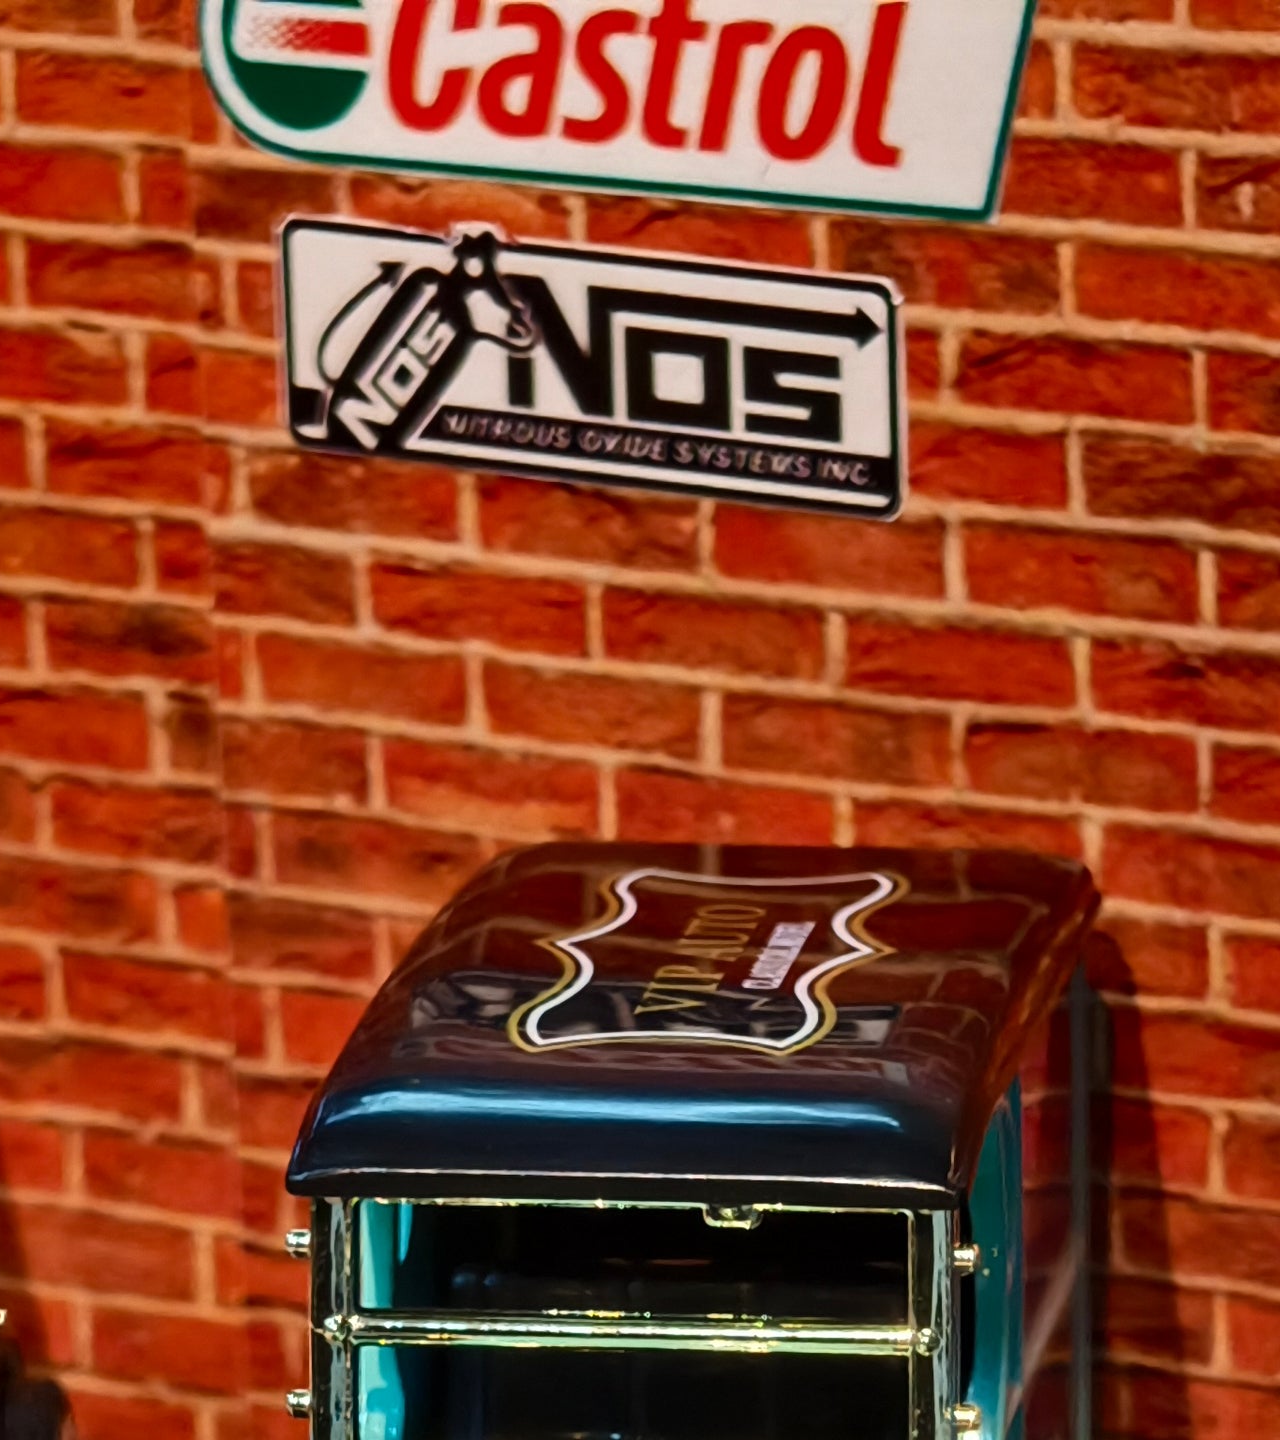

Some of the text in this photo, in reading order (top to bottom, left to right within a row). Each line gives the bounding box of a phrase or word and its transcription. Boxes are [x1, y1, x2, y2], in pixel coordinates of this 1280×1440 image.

[387, 0, 903, 169] Castrol
[334, 283, 457, 451] NOS
[502, 273, 843, 444] NOS
[633, 903, 767, 1015] VIP AUTO
